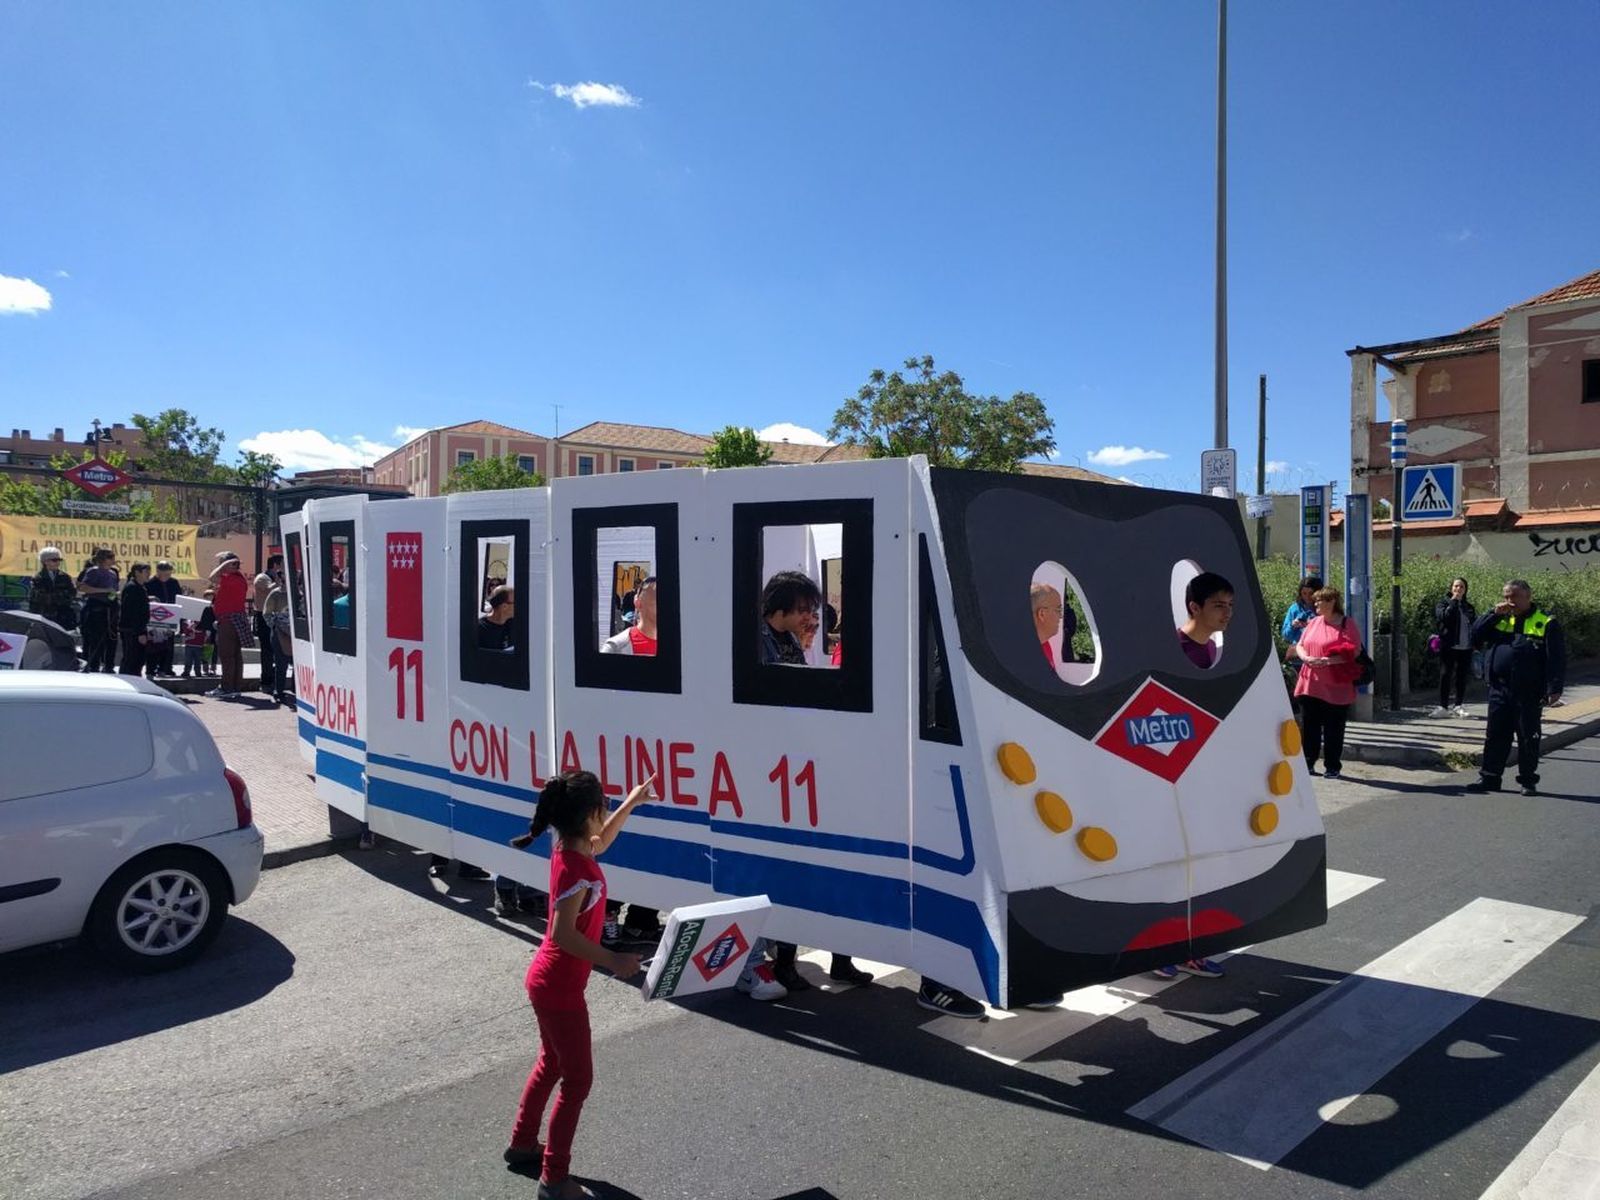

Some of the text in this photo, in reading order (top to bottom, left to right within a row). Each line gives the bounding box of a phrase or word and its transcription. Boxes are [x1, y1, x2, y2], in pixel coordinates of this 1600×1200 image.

[84, 471, 114, 482] Metro
[38, 522, 184, 542] CARABANCHEL EXIGE
[21, 540, 38, 553] LA
[155, 545, 171, 558] DE
[177, 546, 192, 558] LA
[388, 646, 424, 722] 11
[1129, 716, 1190, 745] Metro
[450, 719, 818, 827] CON LA LINEA 11
[710, 938, 734, 967] Metro
